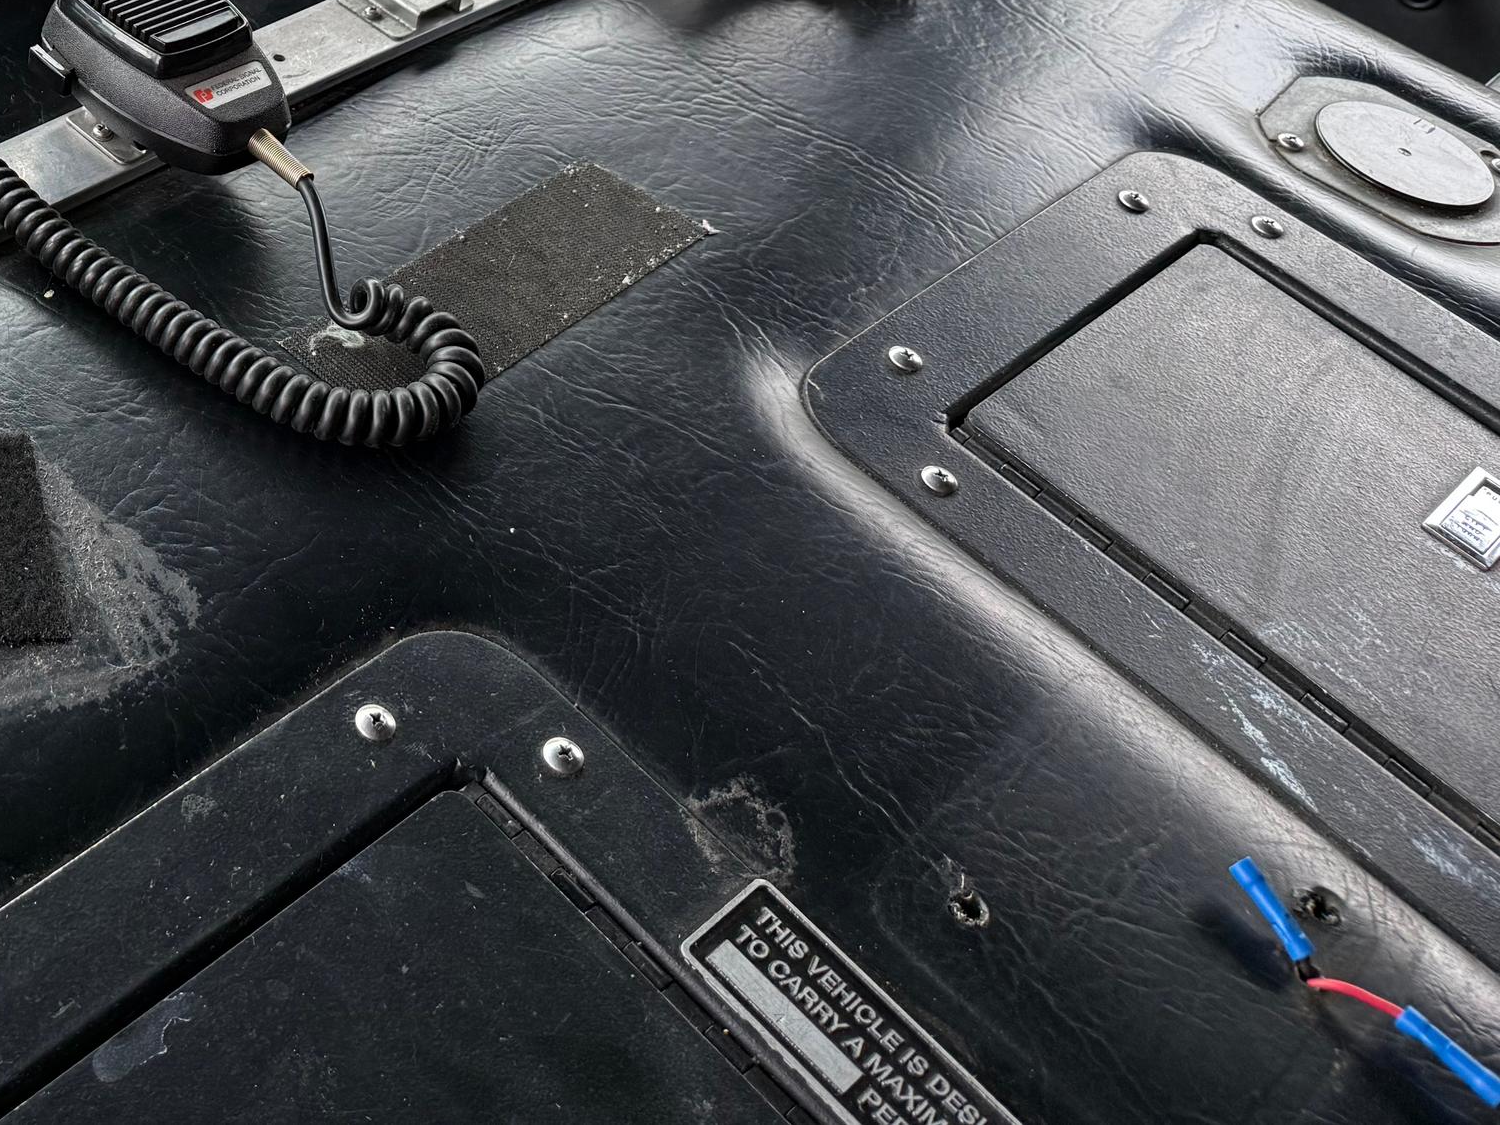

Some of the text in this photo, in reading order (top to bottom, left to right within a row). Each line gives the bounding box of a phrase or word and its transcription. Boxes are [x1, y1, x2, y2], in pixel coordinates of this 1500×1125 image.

[211, 66, 262, 91] FEDERAL SIGNAL
[216, 75, 261, 97] CORPORATION
[734, 921, 774, 960] TO
[766, 957, 851, 1035] CARRY
[840, 1035, 865, 1060] A
[753, 905, 810, 961] THIS
[804, 953, 907, 1053] VEHICLE
[899, 1046, 930, 1077] IS
